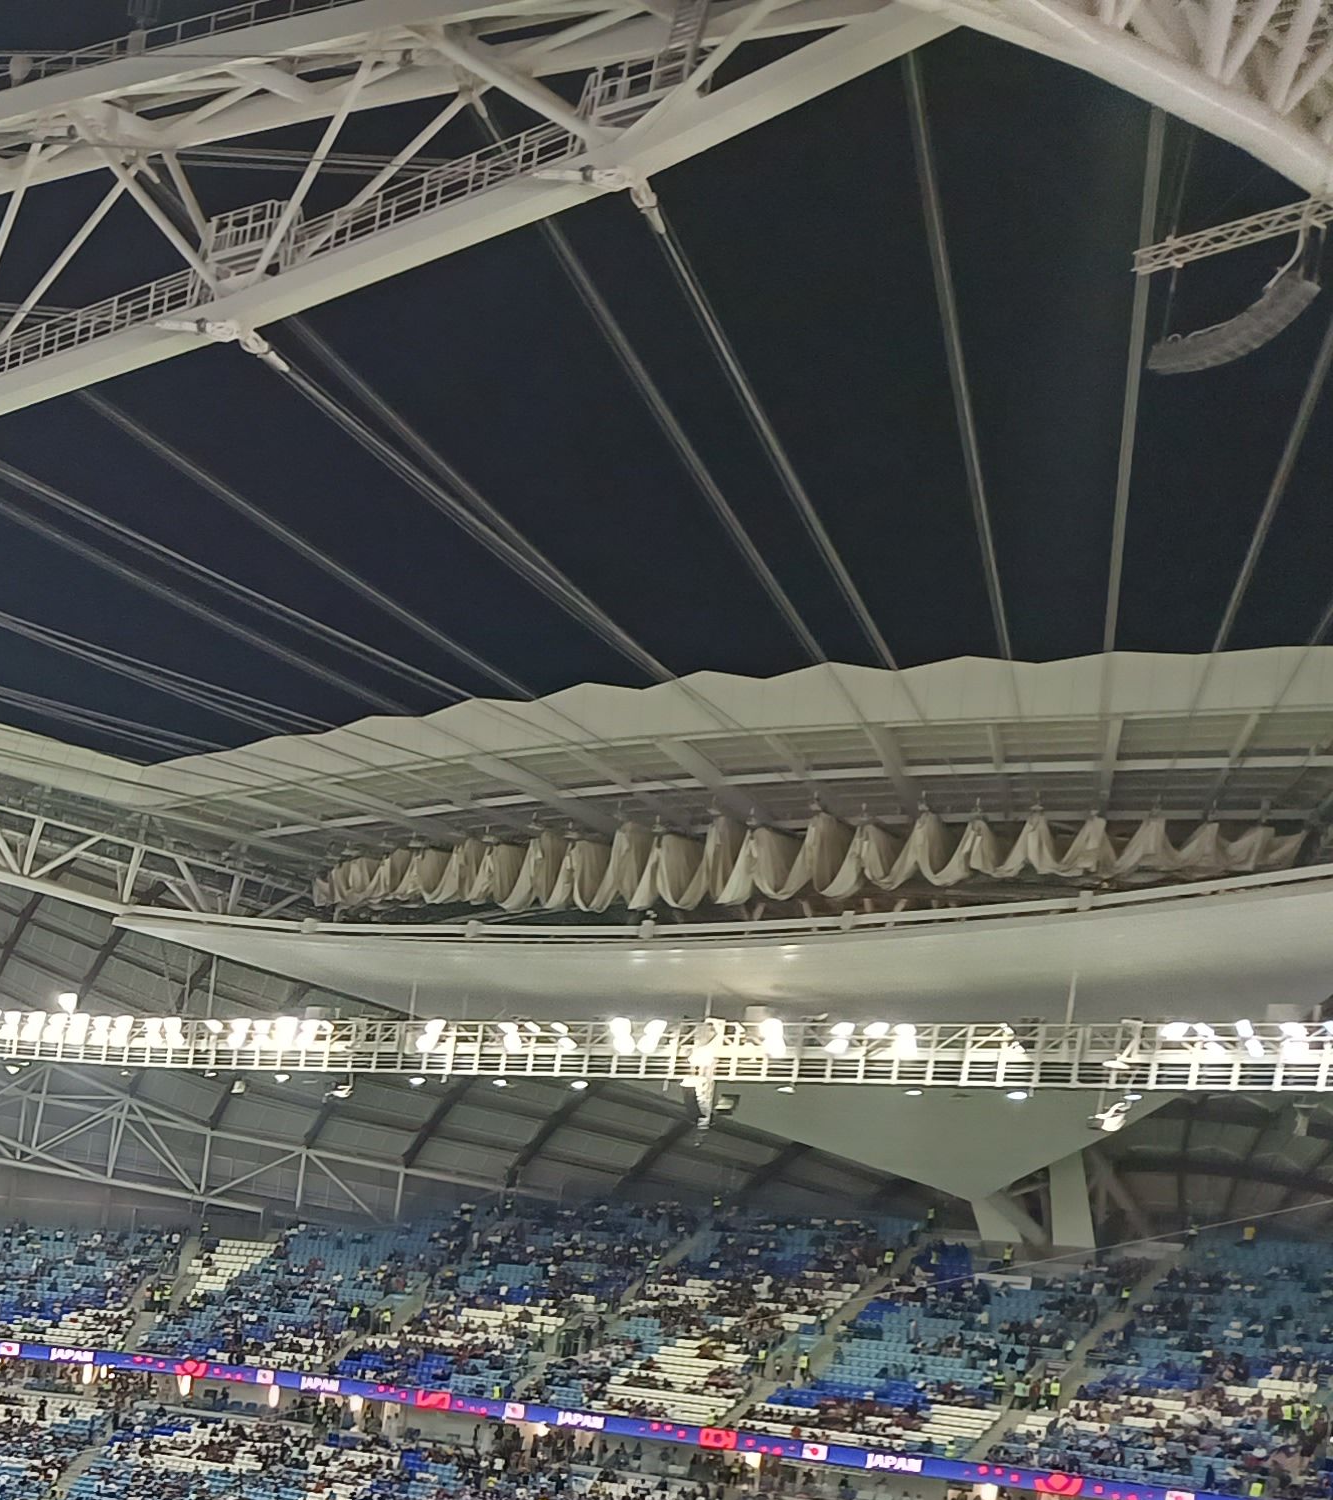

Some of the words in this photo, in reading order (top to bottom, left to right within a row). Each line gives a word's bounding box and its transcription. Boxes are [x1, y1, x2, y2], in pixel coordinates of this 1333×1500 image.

[50, 1348, 95, 1363] JAPAN
[299, 1376, 340, 1391] JAPAN
[556, 1411, 606, 1429] JAPAN
[866, 1453, 923, 1473] JAPAN
